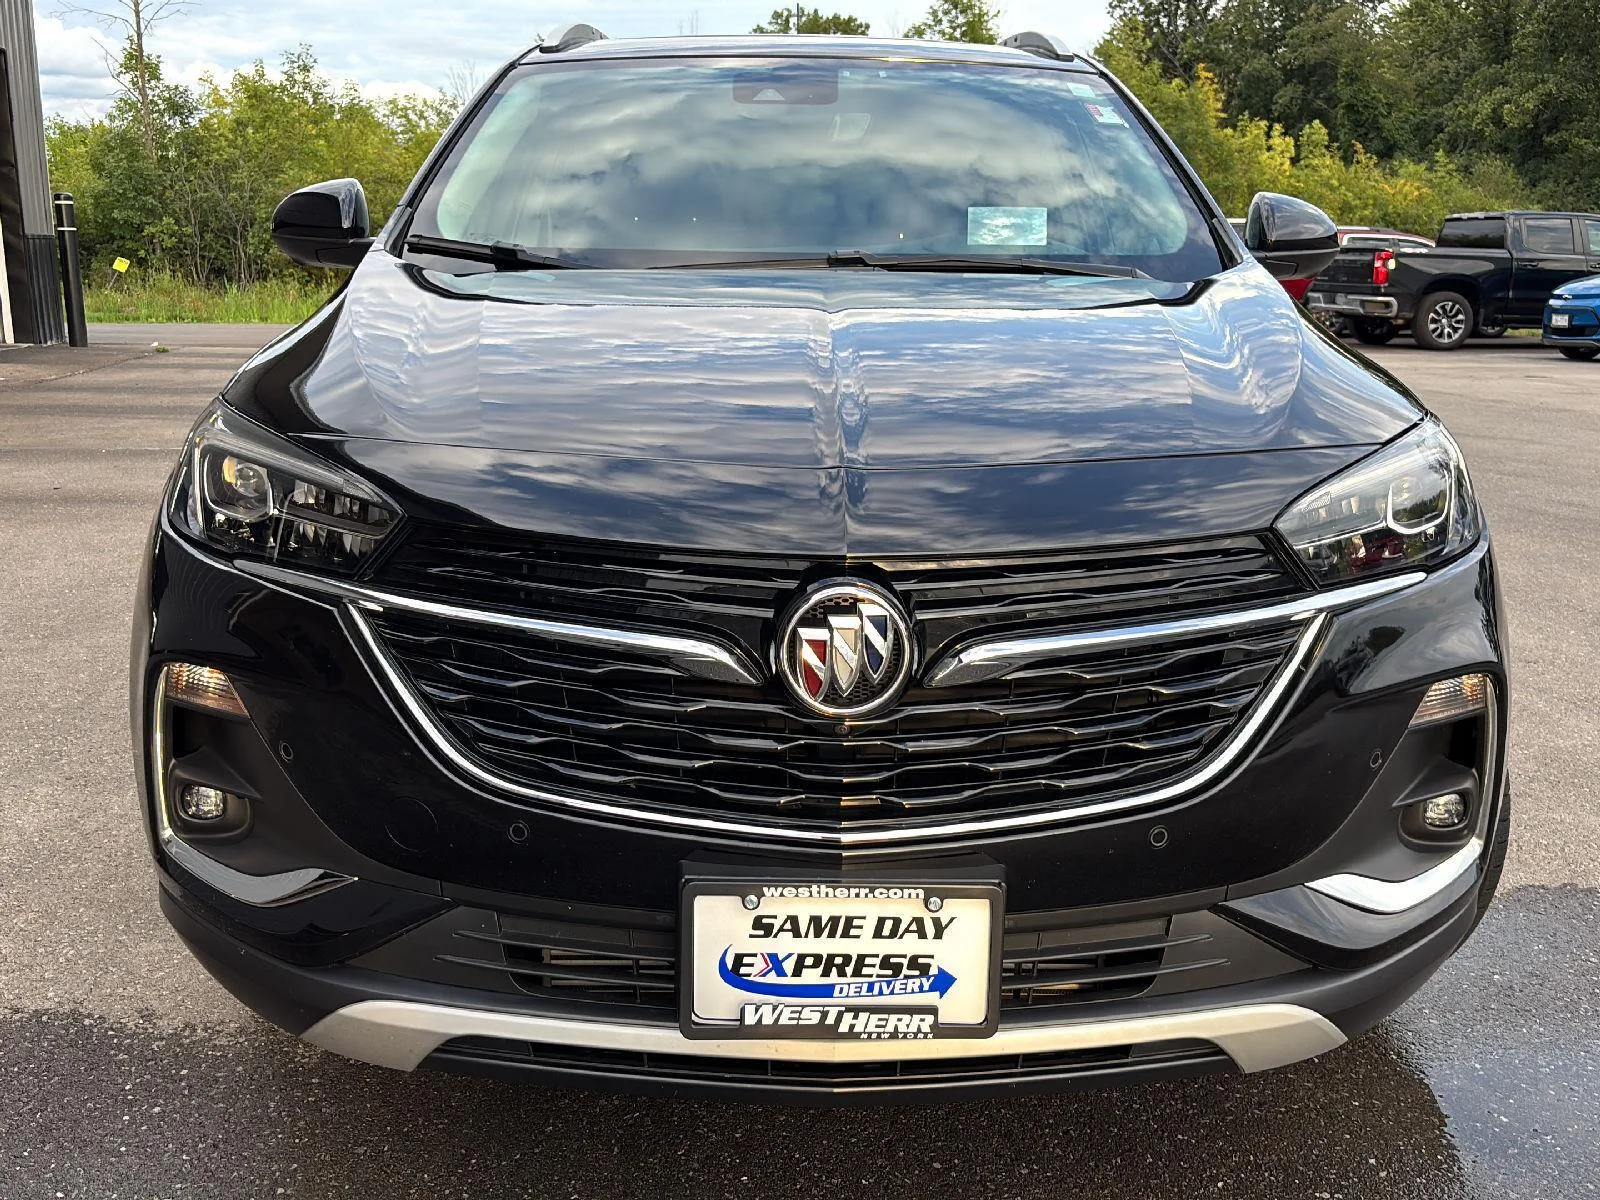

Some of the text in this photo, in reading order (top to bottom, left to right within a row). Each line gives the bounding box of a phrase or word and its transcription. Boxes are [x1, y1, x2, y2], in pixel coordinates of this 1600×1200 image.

[762, 884, 925, 899] westherr.com
[748, 914, 957, 940] SAME DAY
[729, 952, 935, 978] EXPRESS
[832, 976, 937, 998] DELIVERY
